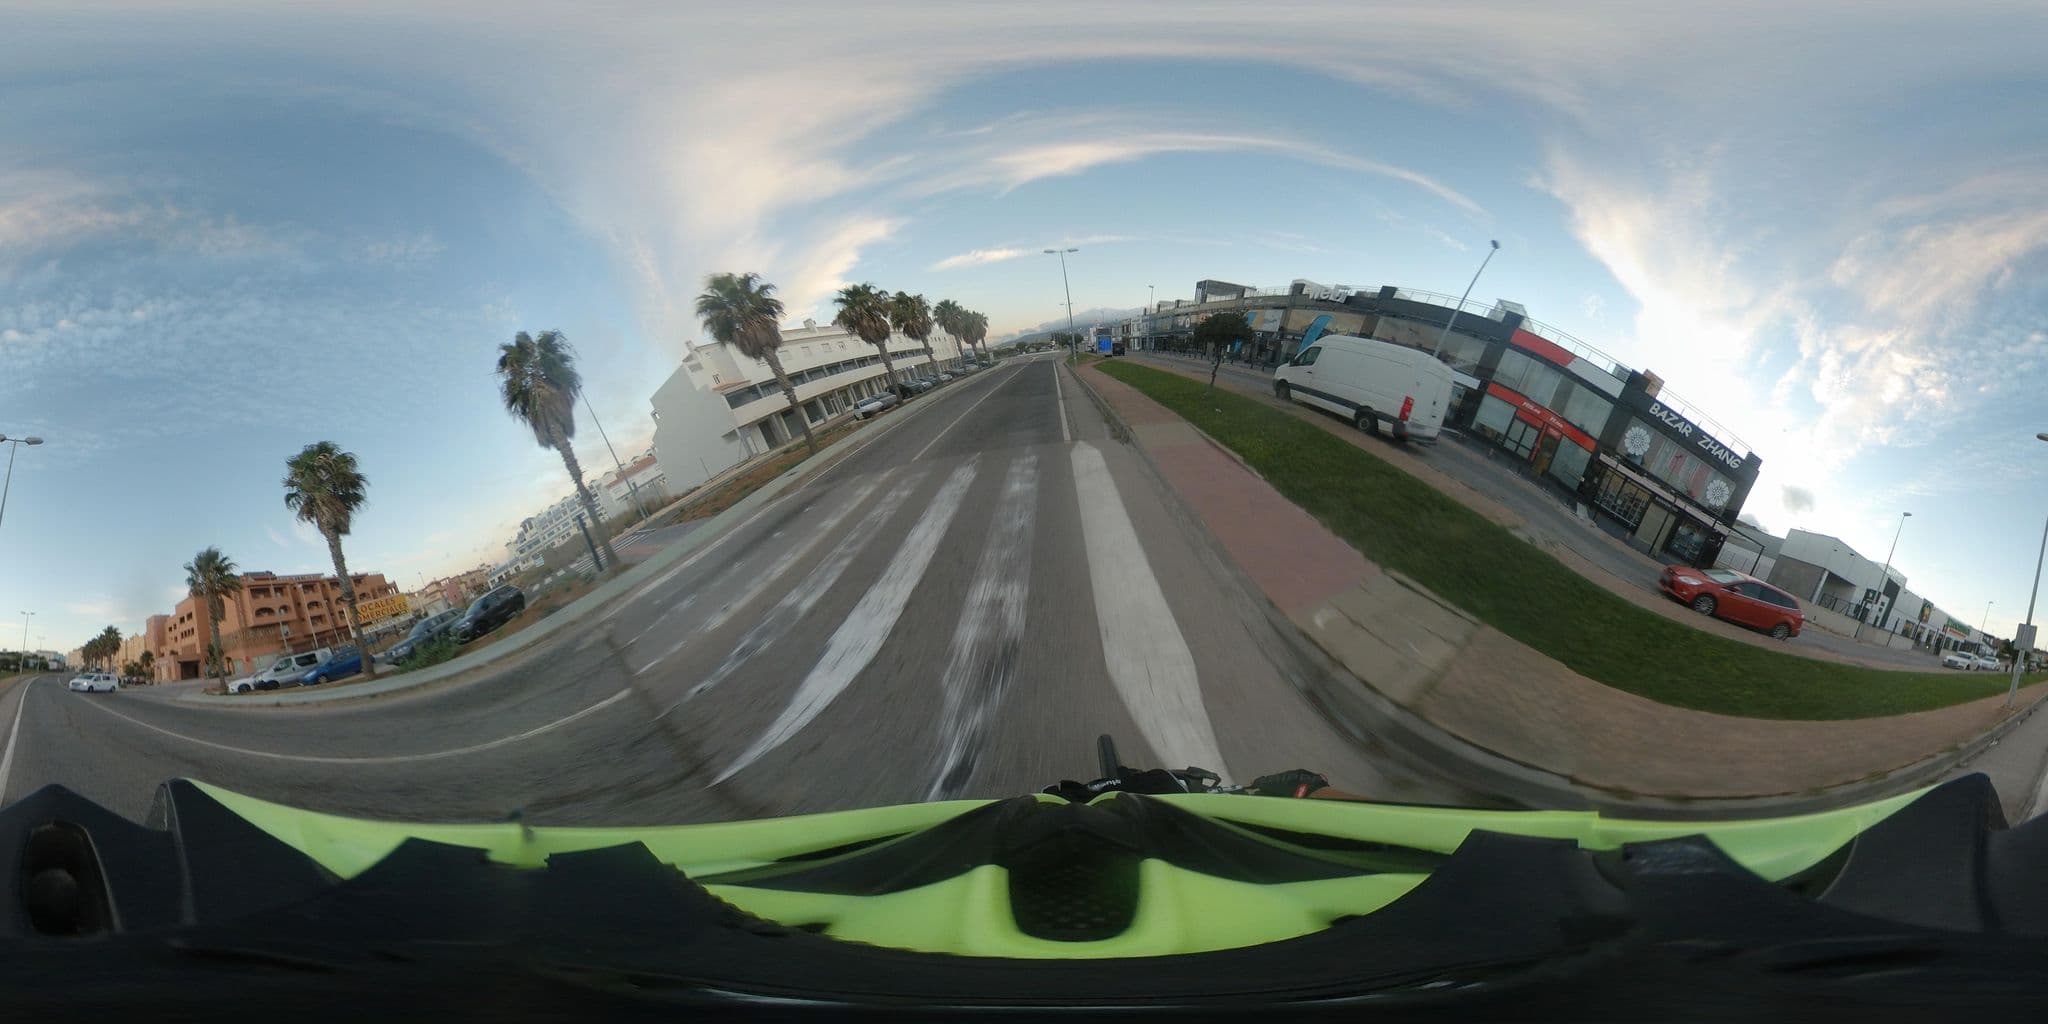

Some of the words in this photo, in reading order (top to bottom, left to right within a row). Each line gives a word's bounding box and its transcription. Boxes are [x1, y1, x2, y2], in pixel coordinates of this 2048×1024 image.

[1649, 403, 1692, 437] BAZAR
[1697, 435, 1741, 469] ZHANG
[357, 599, 396, 614] OCALES
